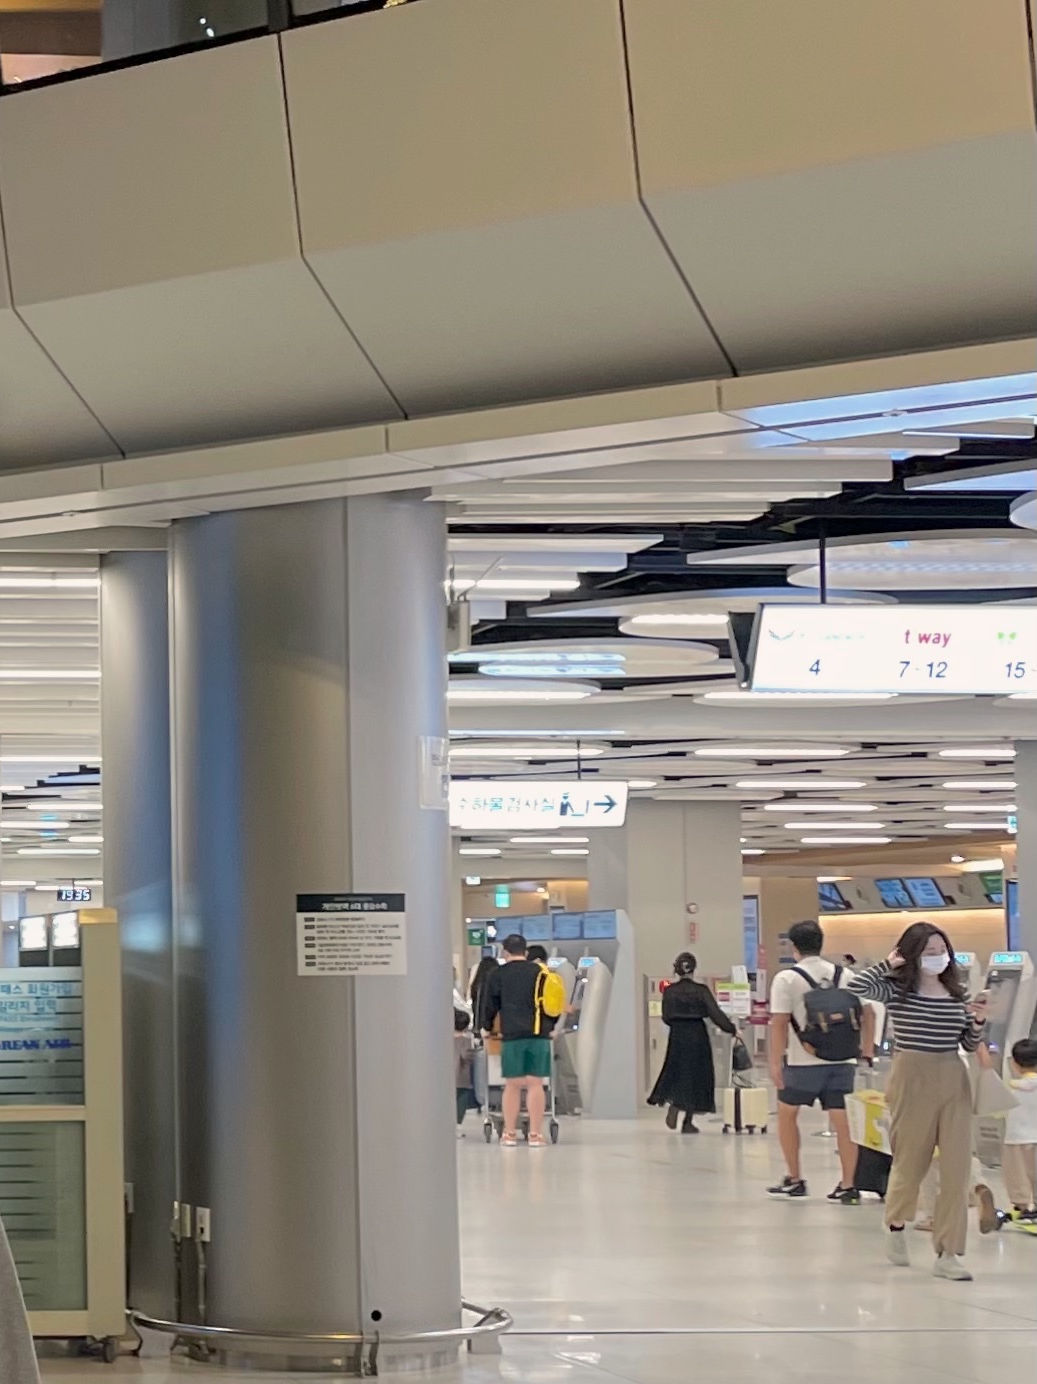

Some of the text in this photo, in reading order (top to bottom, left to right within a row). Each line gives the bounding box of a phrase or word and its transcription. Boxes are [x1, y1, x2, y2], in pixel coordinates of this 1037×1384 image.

[808, 658, 821, 676] 4
[899, 660, 948, 678] 7 12
[1005, 661, 1026, 678] 15
